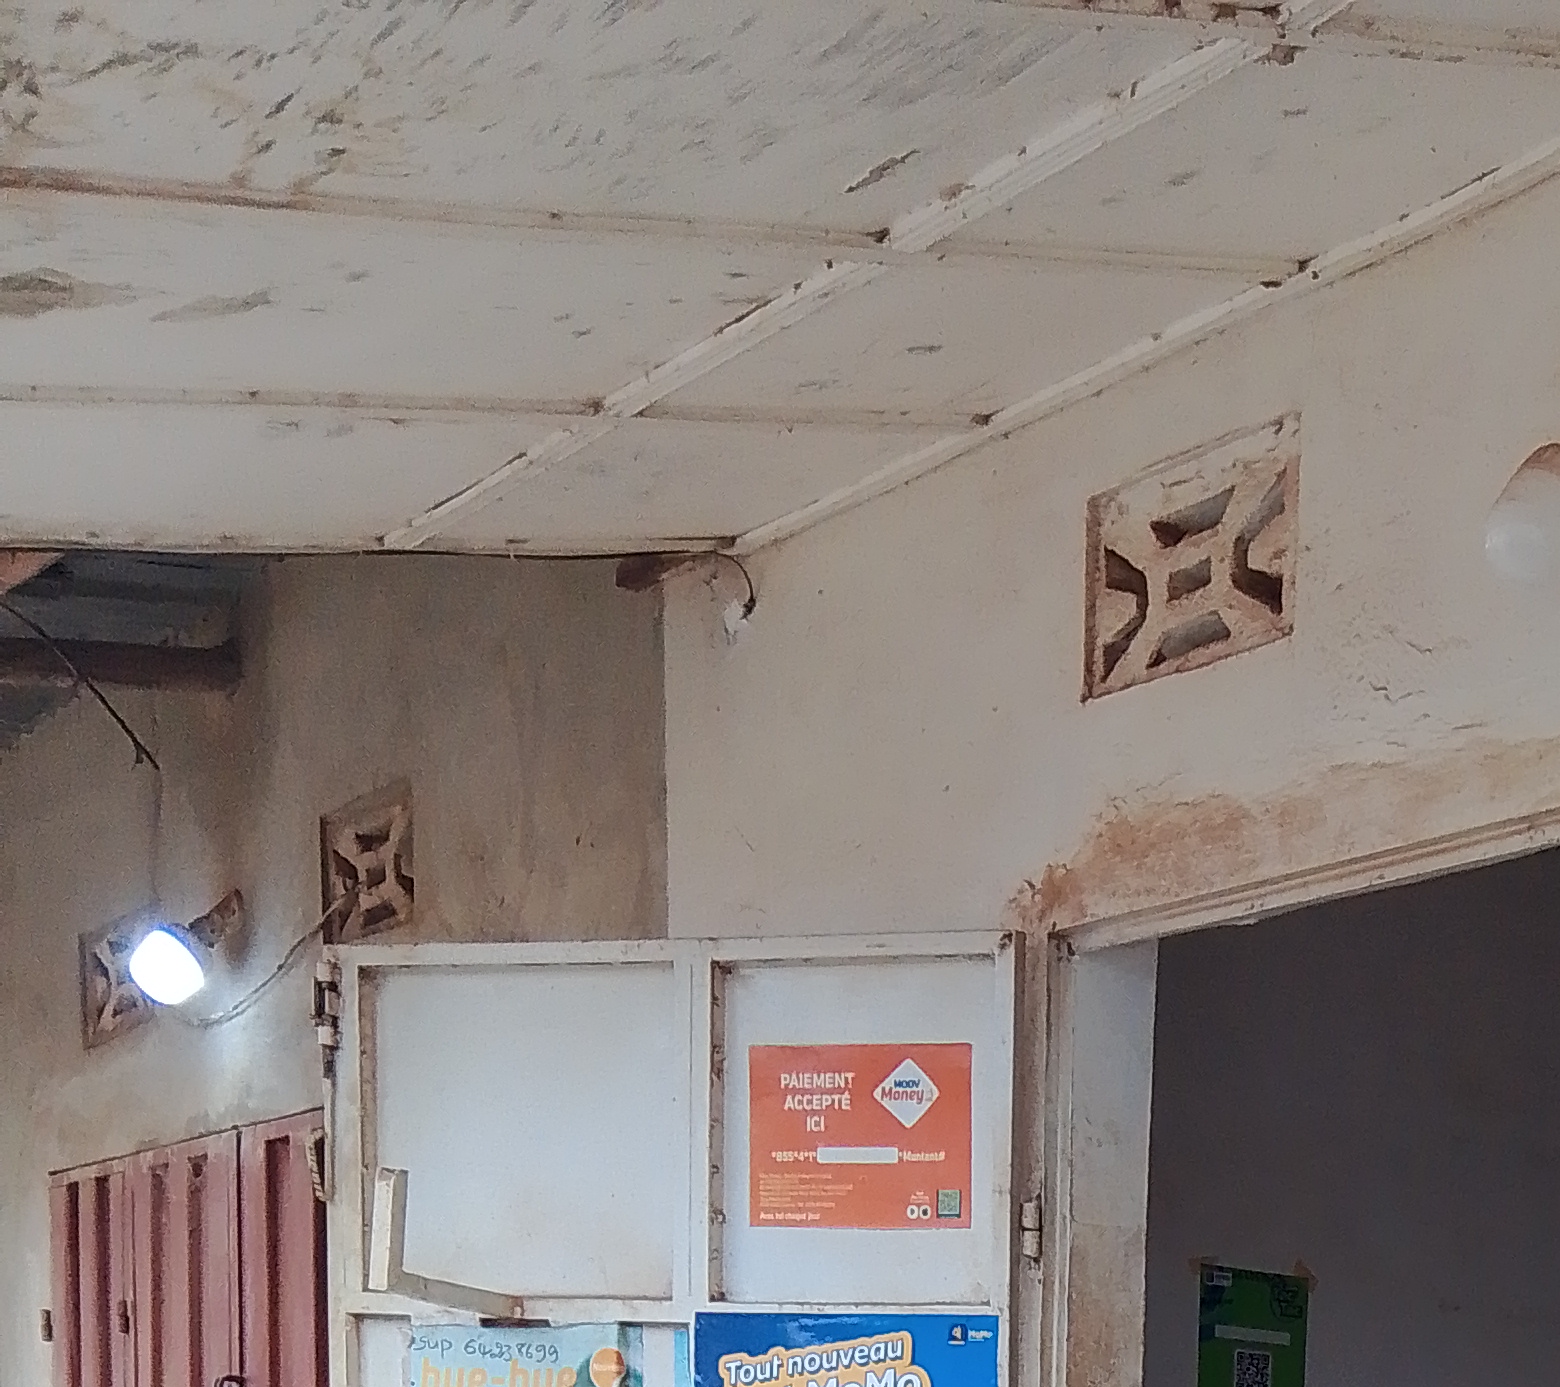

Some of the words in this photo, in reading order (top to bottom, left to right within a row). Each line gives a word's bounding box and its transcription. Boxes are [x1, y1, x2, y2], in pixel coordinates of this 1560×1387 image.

[780, 1071, 856, 1089] PAIEMENT
[784, 1090, 852, 1111] ACCEPTÉ
[880, 1086, 925, 1105] Money
[806, 1115, 825, 1132] ICI
[725, 1353, 783, 1386] Tout
[787, 1338, 903, 1377] nouveau
